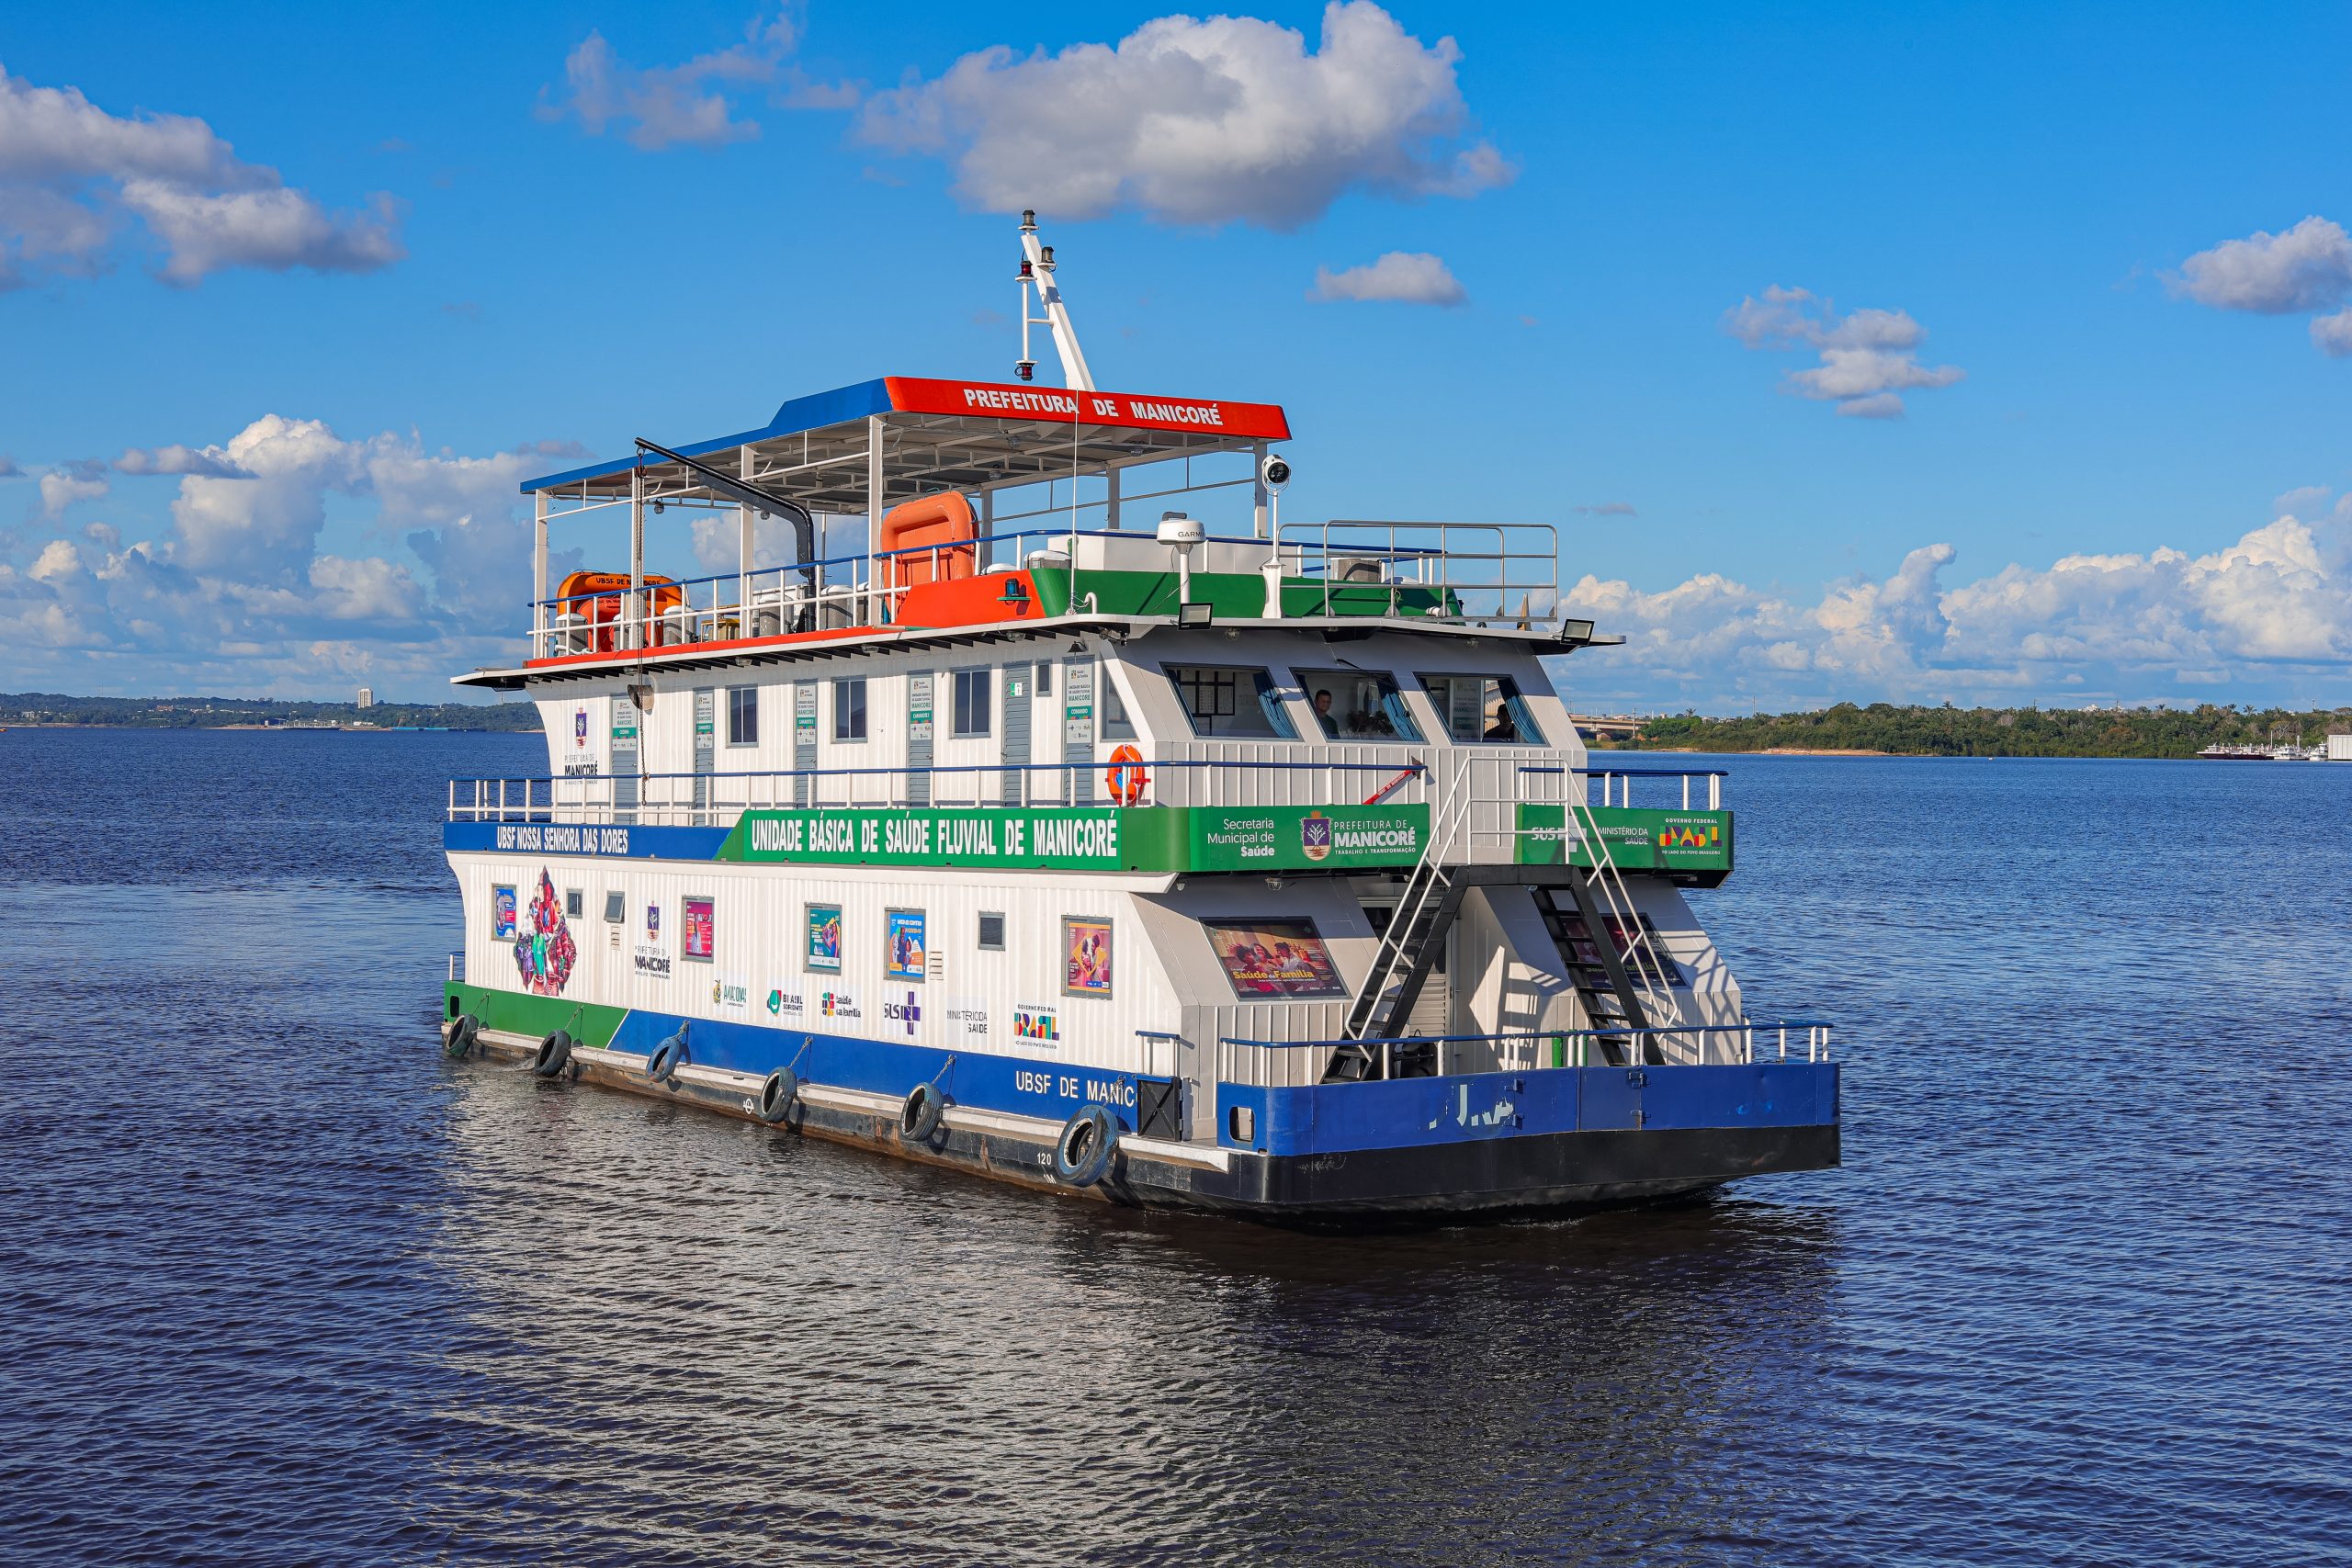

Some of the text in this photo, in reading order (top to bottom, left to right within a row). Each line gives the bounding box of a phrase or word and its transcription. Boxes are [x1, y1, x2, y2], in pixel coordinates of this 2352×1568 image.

[964, 389, 1224, 425] PREFEITURA DE MANICORÉ
[595, 577, 615, 585] UBSF
[1223, 818, 1274, 830] Secretaria
[1334, 819, 1408, 830] PREFEITURA DE
[752, 810, 1117, 857] UNIDADE BÁSICA DE SAÚDE FLUVIAL DE MANICORÉ
[1531, 827, 1556, 840] SUS
[1599, 826, 1648, 836] MINISTÉRIO DA
[497, 826, 628, 853] UBSF NOSSA SENHORA DAS DORES
[1207, 831, 1274, 846] Municipal de
[1334, 827, 1416, 848] MANICORÉ
[1624, 835, 1648, 845] SAÚDE
[1240, 845, 1275, 857] Saúde
[1232, 970, 1269, 979] Saúde
[1274, 969, 1315, 978] Família
[1015, 1070, 1137, 1107] UBSF DE MANIC
[1037, 1153, 1051, 1165] 120
